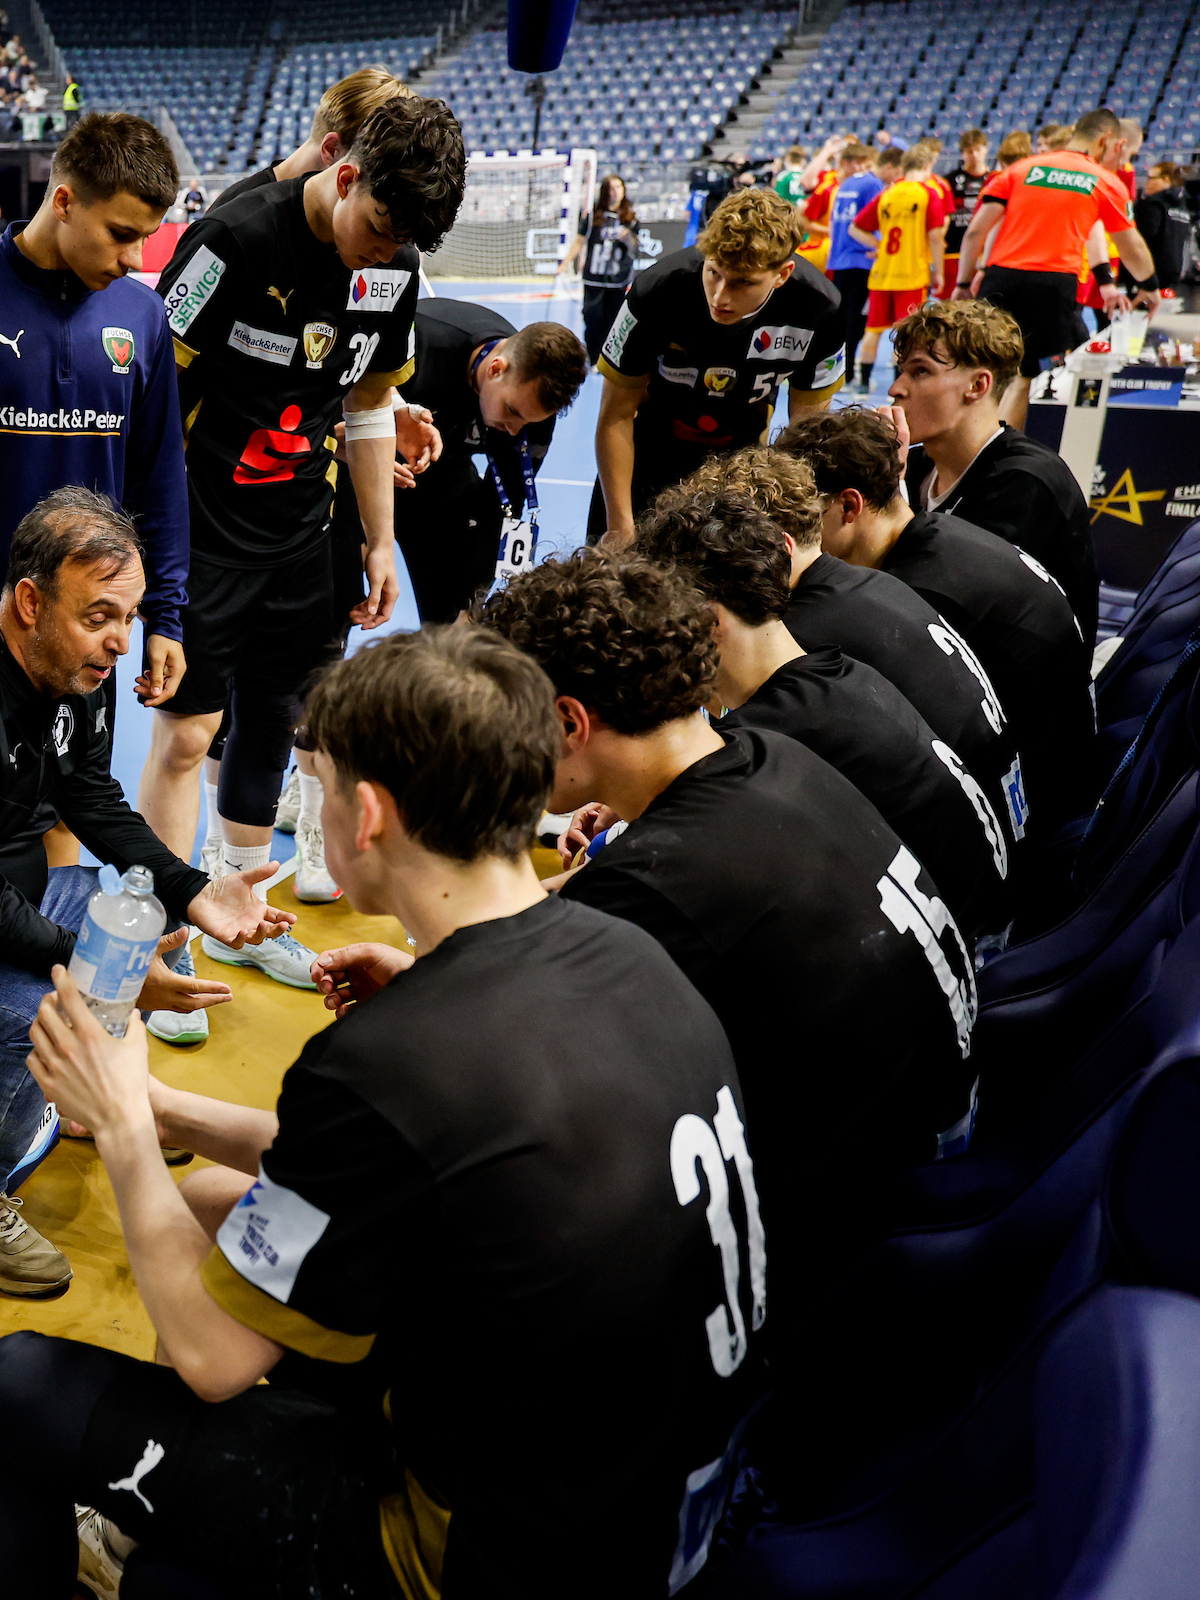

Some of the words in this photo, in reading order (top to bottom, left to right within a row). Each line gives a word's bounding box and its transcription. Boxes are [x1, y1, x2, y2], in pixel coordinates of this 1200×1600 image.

[1047, 170, 1093, 191] DEKRA
[887, 227, 902, 255] 8
[172, 260, 223, 329] SERVICE
[234, 328, 292, 355] Kieback&Peter
[774, 336, 809, 352] BEW
[510, 539, 525, 566] C
[875, 844, 979, 1060] 15
[669, 1084, 767, 1379] 31
